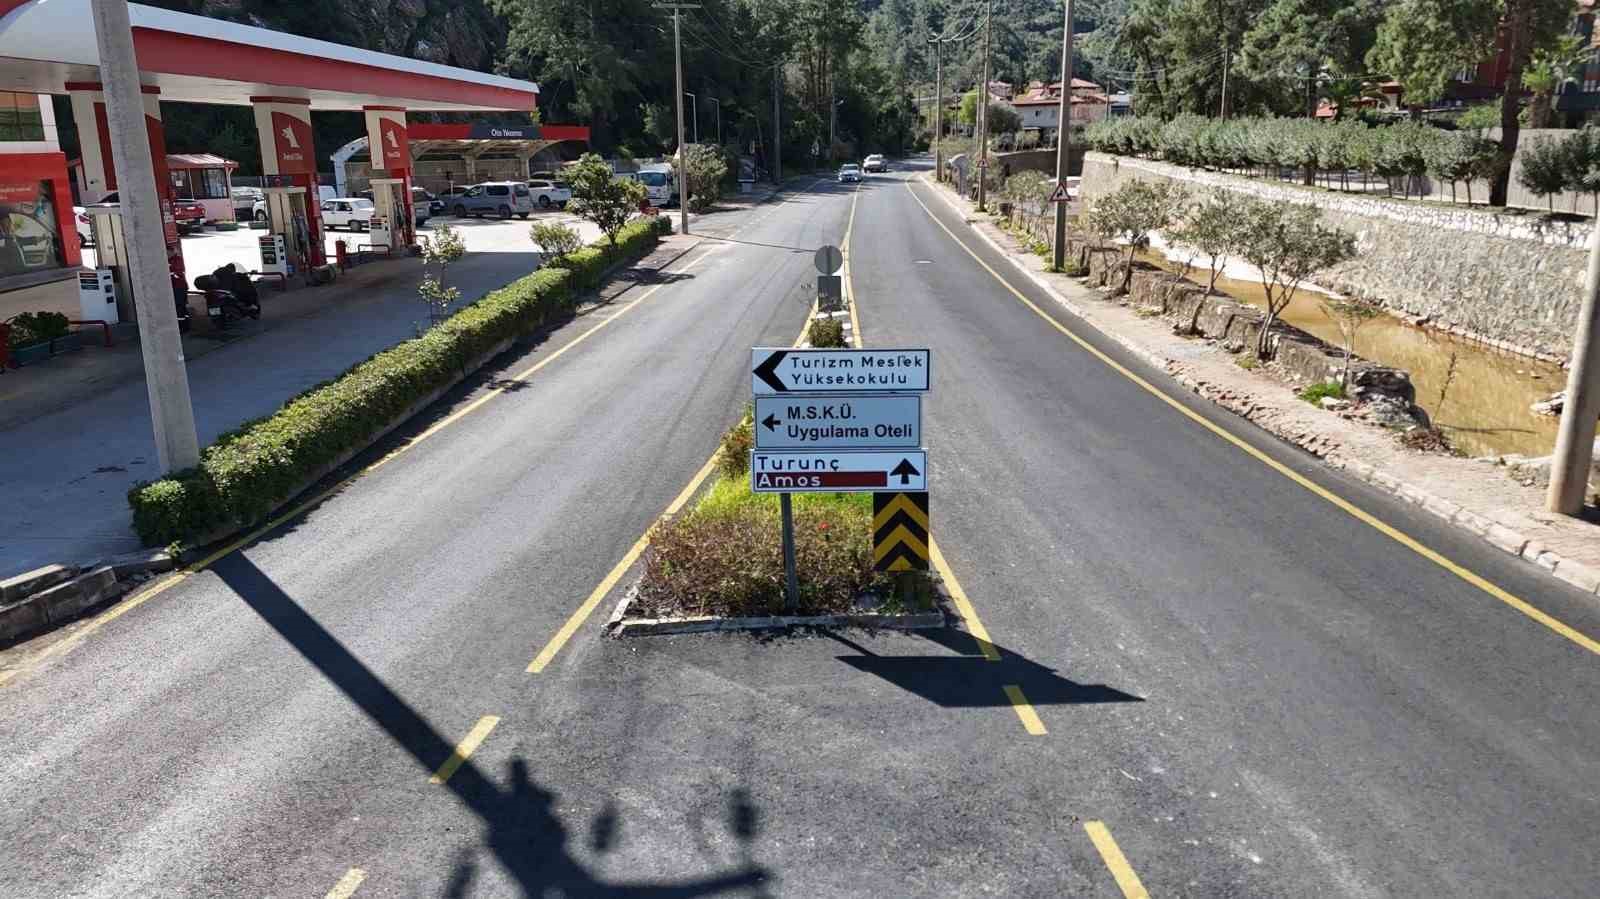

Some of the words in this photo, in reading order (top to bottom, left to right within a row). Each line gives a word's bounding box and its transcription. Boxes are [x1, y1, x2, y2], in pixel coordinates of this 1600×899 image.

[791, 356, 854, 369] Turizm
[861, 355, 923, 368] Meslek
[791, 373, 908, 385] Yüksekokulu
[787, 403, 857, 420] M.S.K.Ü.
[787, 424, 869, 441] Uygulama
[874, 423, 912, 438] Oteli
[757, 456, 840, 471] Turunç
[758, 473, 822, 487] Amos
